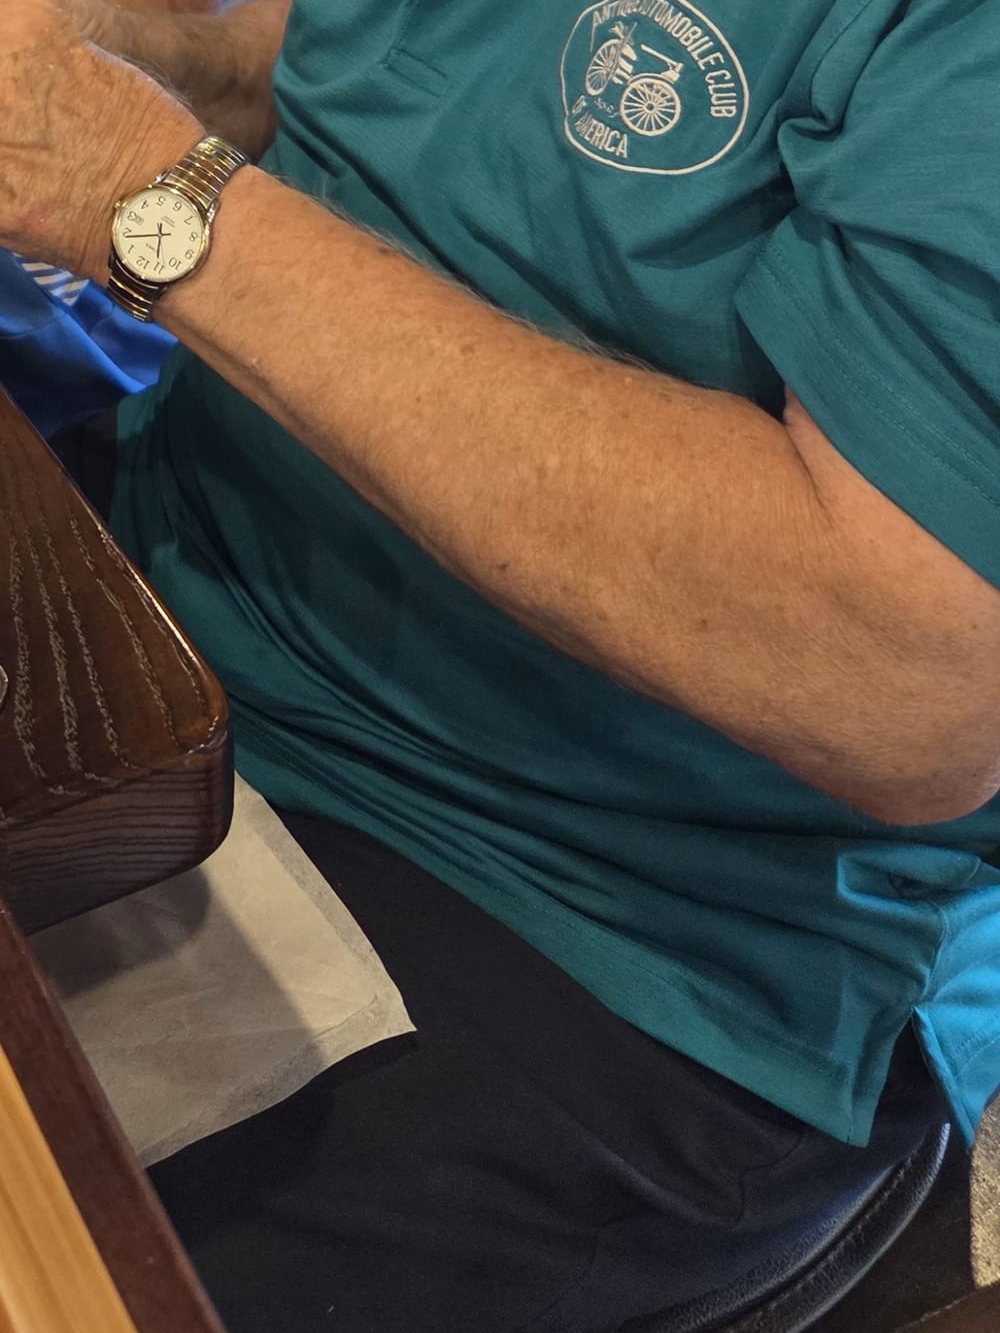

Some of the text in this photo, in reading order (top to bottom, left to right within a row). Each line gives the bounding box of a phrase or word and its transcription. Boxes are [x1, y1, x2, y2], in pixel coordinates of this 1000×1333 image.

[705, 69, 738, 117] CLUB
[574, 112, 628, 158] AMERICA
[140, 199, 149, 210] 4
[156, 195, 166, 207] 5
[172, 201, 183, 212] 6
[127, 210, 137, 220] 3
[184, 215, 194, 226] 7
[122, 227, 132, 237] 2
[188, 231, 199, 243] 8
[127, 244, 135, 254] 1
[184, 249, 195, 260] 9
[136, 255, 150, 270] 12
[153, 261, 165, 275] 11
[168, 257, 182, 271] 10
